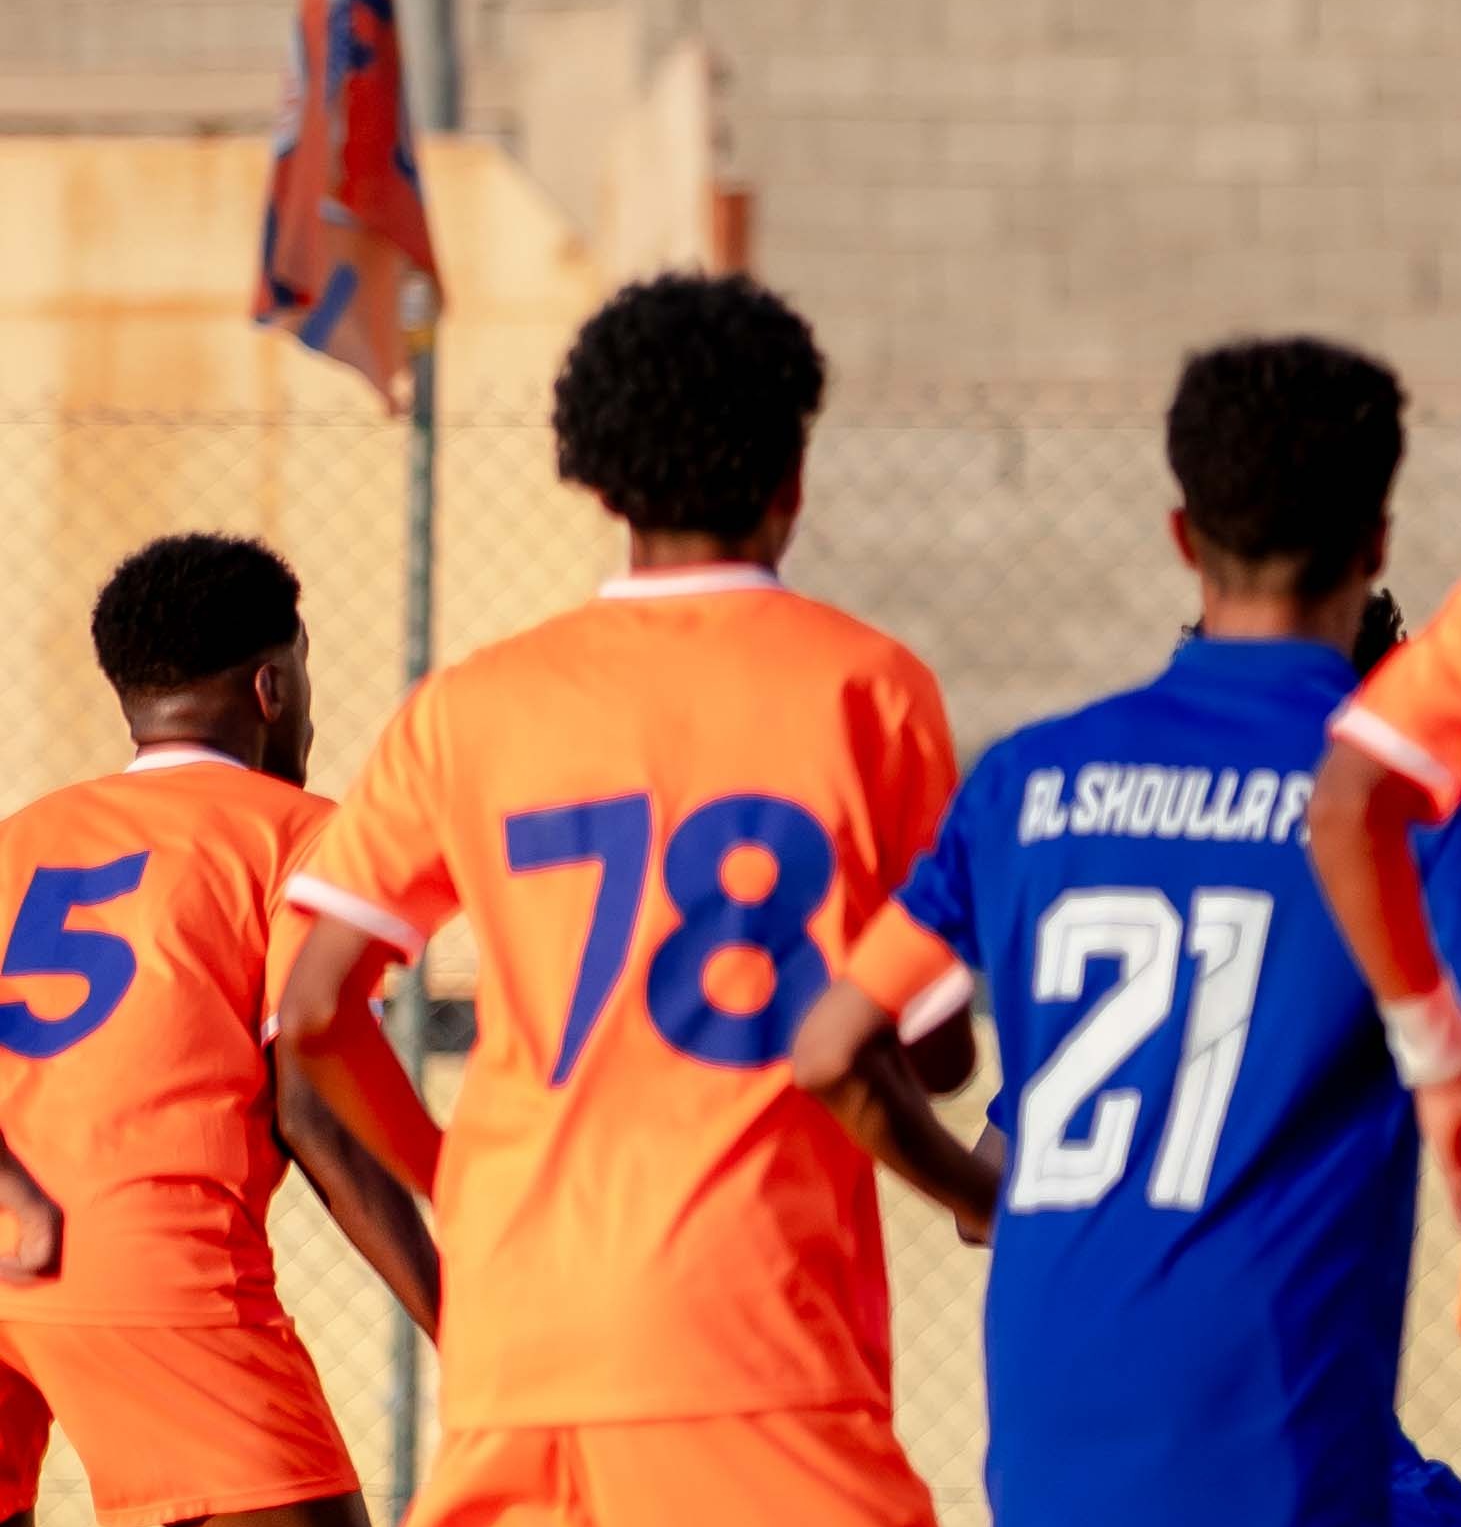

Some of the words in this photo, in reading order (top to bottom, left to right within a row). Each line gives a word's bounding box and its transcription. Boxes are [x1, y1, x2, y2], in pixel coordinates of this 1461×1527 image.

[0, 850, 151, 1059] 5
[503, 790, 838, 1088] 78
[1008, 886, 1275, 1214] 21
